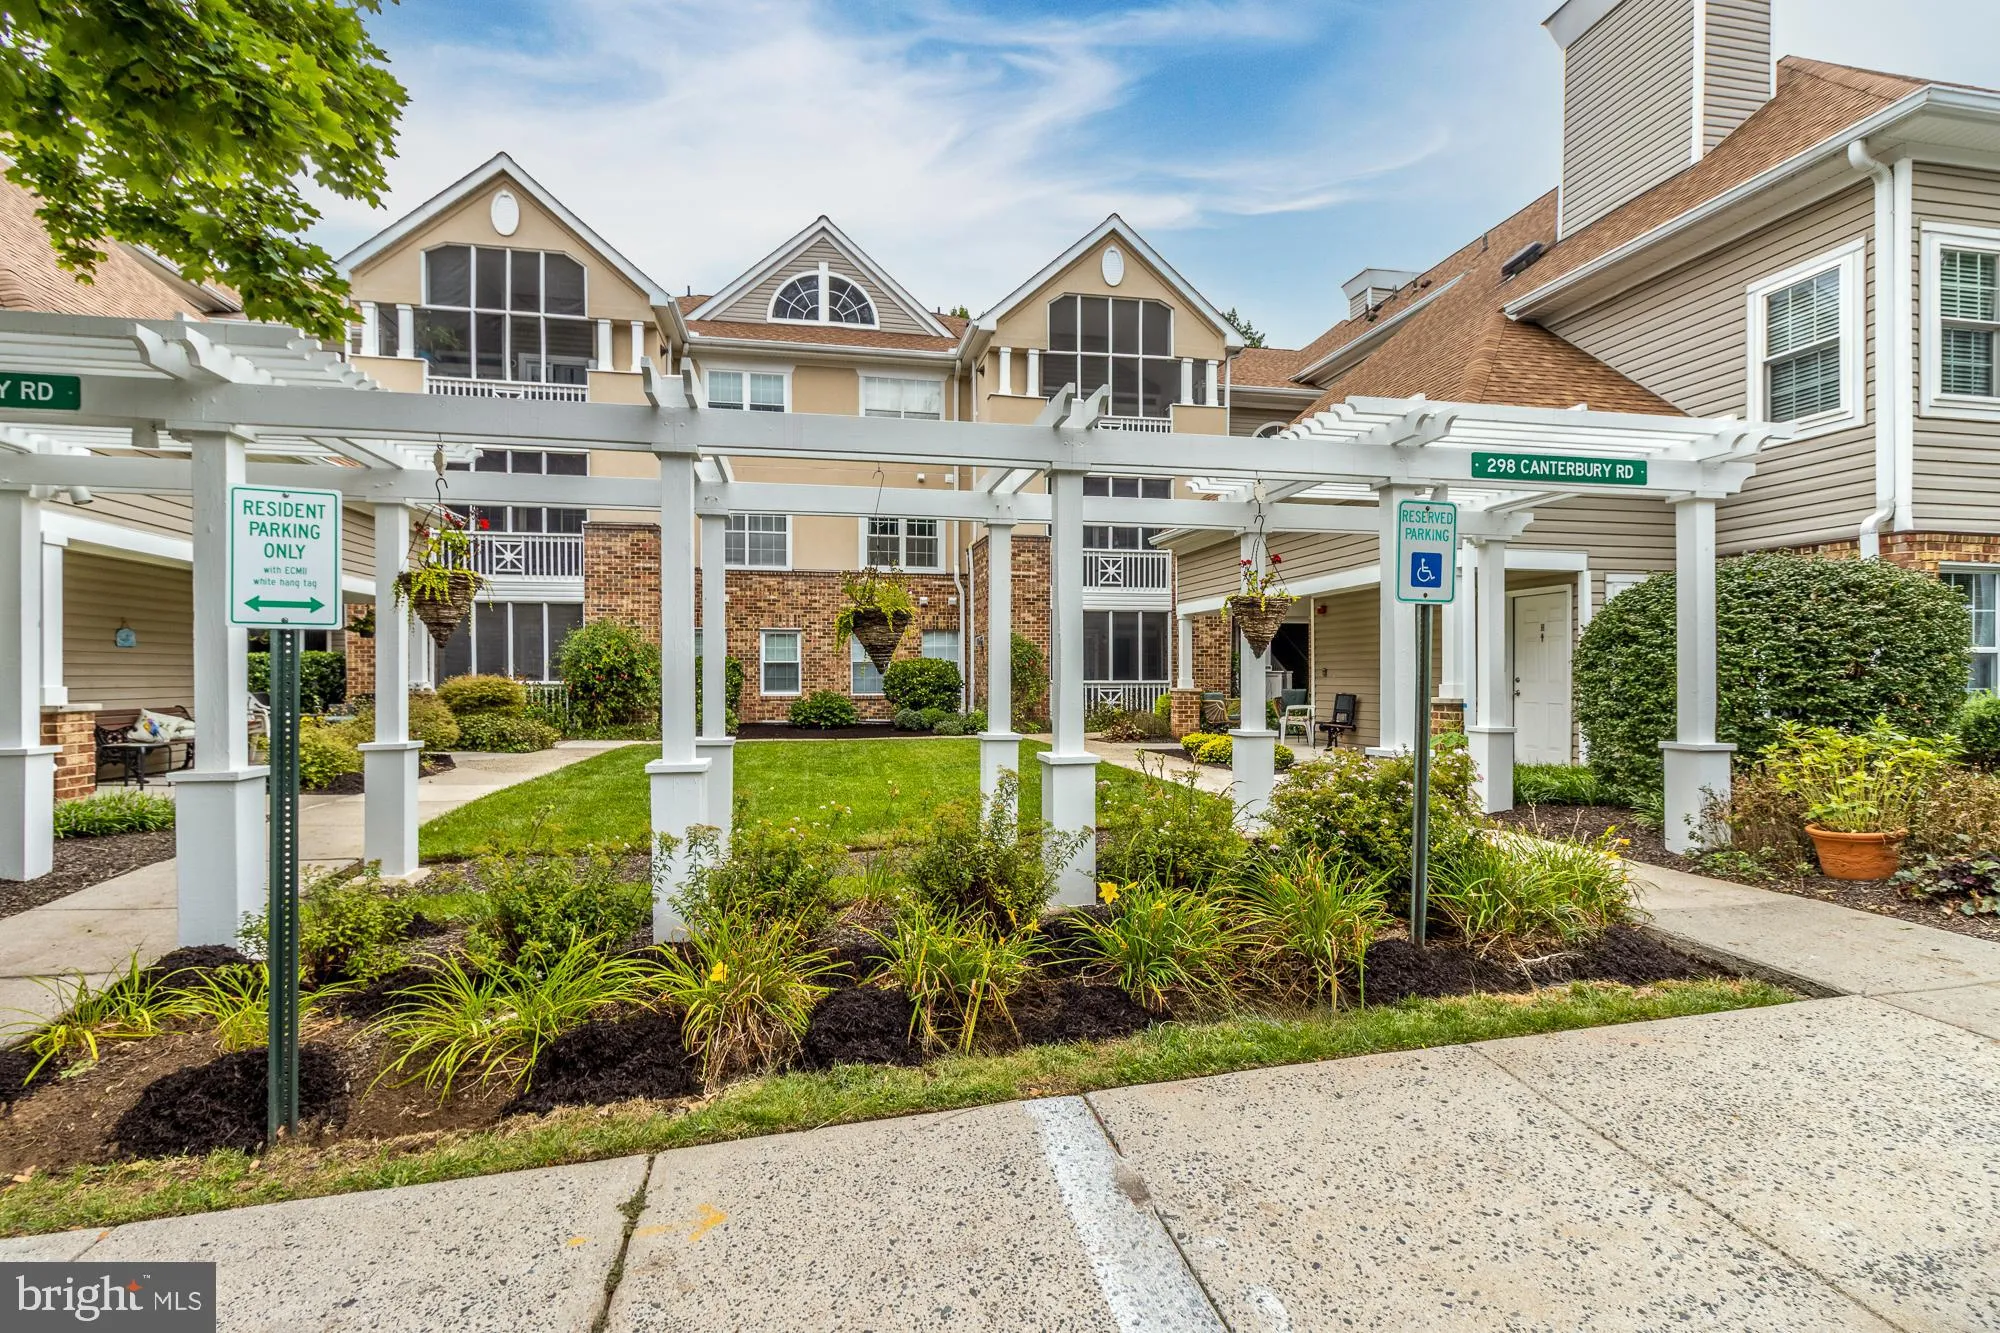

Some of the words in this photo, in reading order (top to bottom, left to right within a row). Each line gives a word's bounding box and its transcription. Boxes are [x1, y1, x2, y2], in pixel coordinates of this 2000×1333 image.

[21, 381, 53, 401] RD
[1487, 458, 1516, 474] 298
[1520, 459, 1612, 478] CANTERBURY
[1616, 464, 1634, 479] RD
[243, 500, 326, 519] RESIDENT
[1402, 510, 1453, 524] RESERVED
[249, 521, 321, 540] PARKING
[1405, 528, 1450, 542] PARKING
[264, 542, 306, 560] ONLY
[264, 566, 282, 574] with
[253, 578, 276, 586] white
[280, 578, 300, 588] hang
[303, 579, 317, 589] tag
